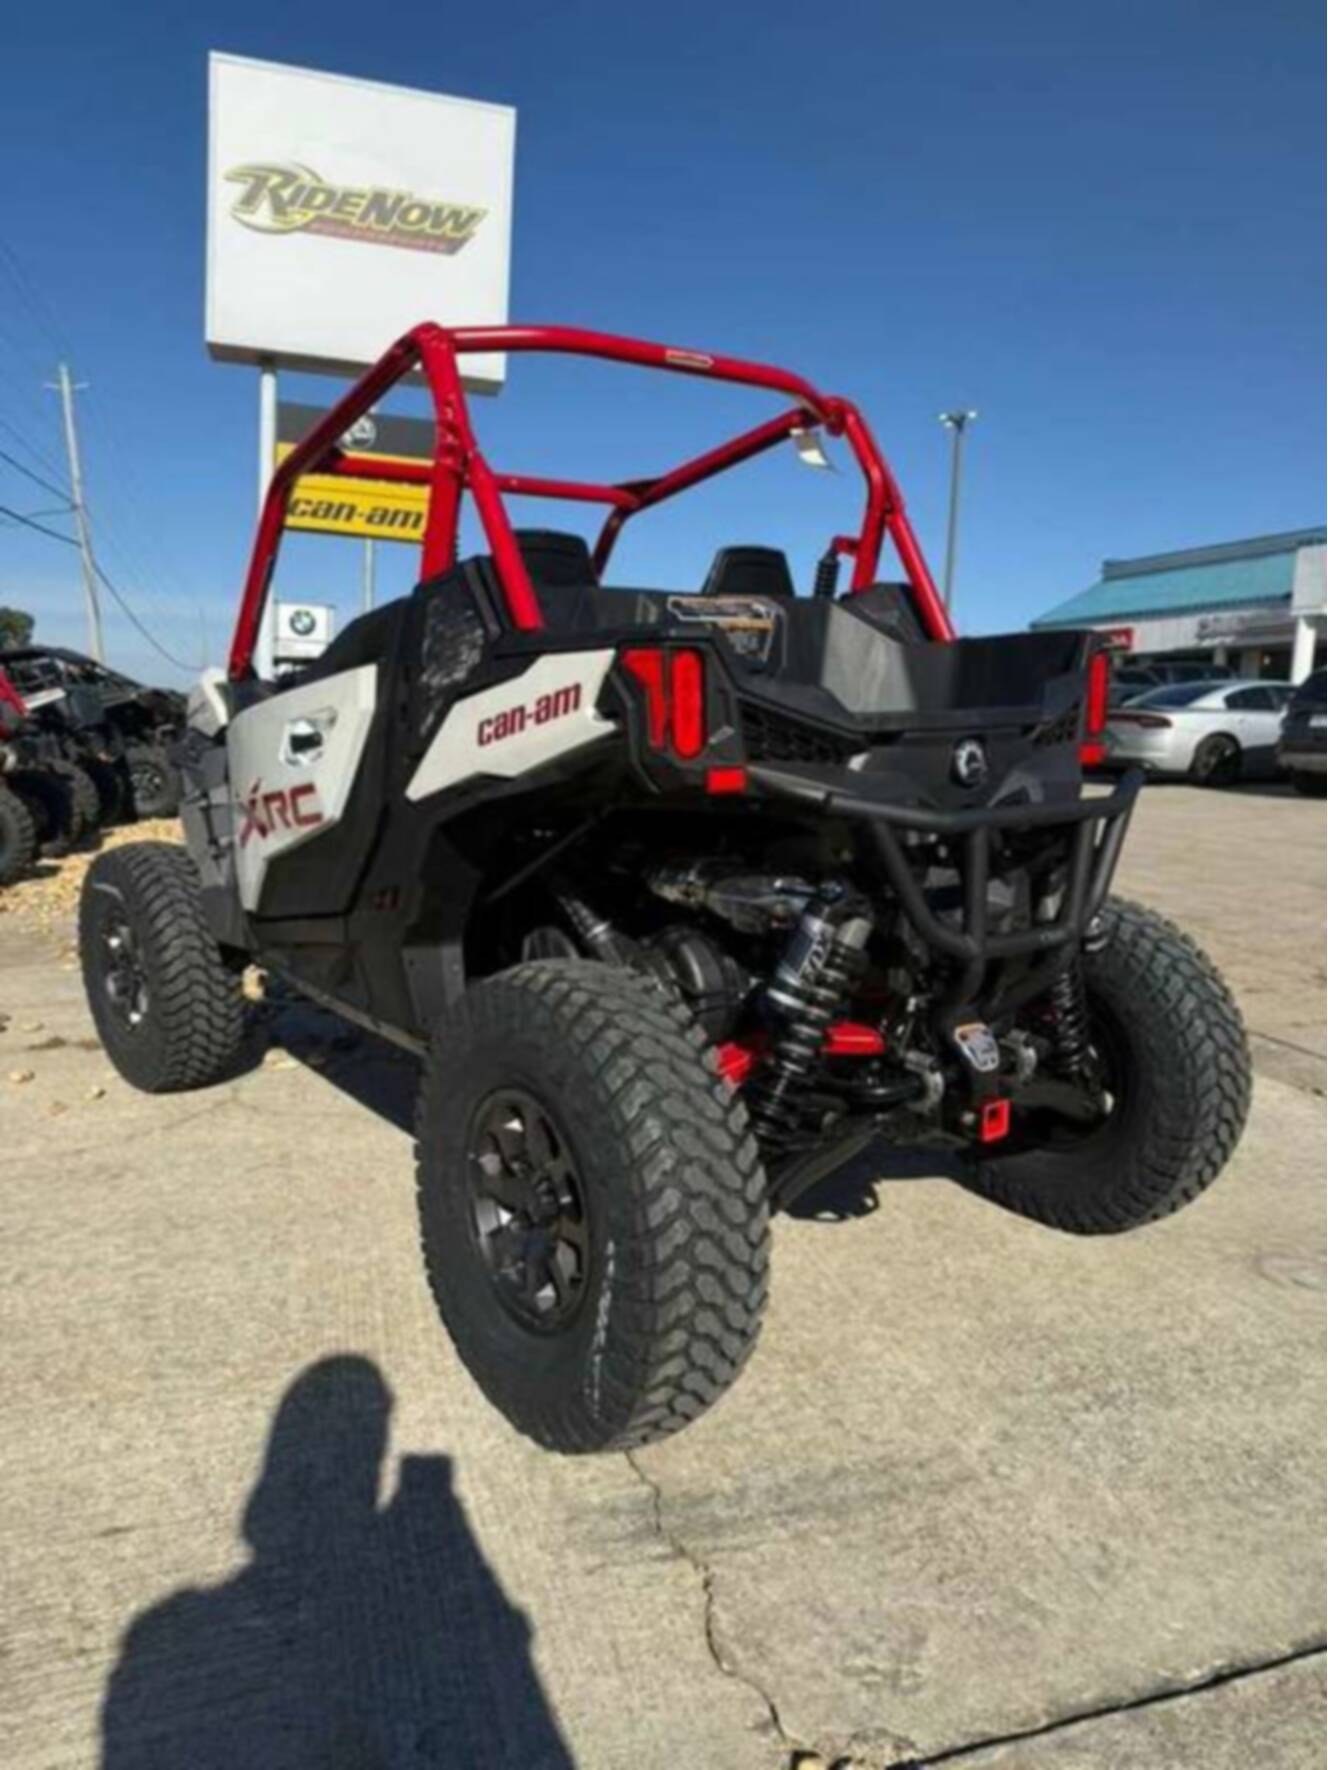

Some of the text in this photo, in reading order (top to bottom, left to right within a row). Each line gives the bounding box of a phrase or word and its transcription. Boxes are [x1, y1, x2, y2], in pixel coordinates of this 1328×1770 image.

[287, 498, 423, 530] can-am
[477, 682, 582, 746] can-am
[237, 777, 323, 849] XRC
